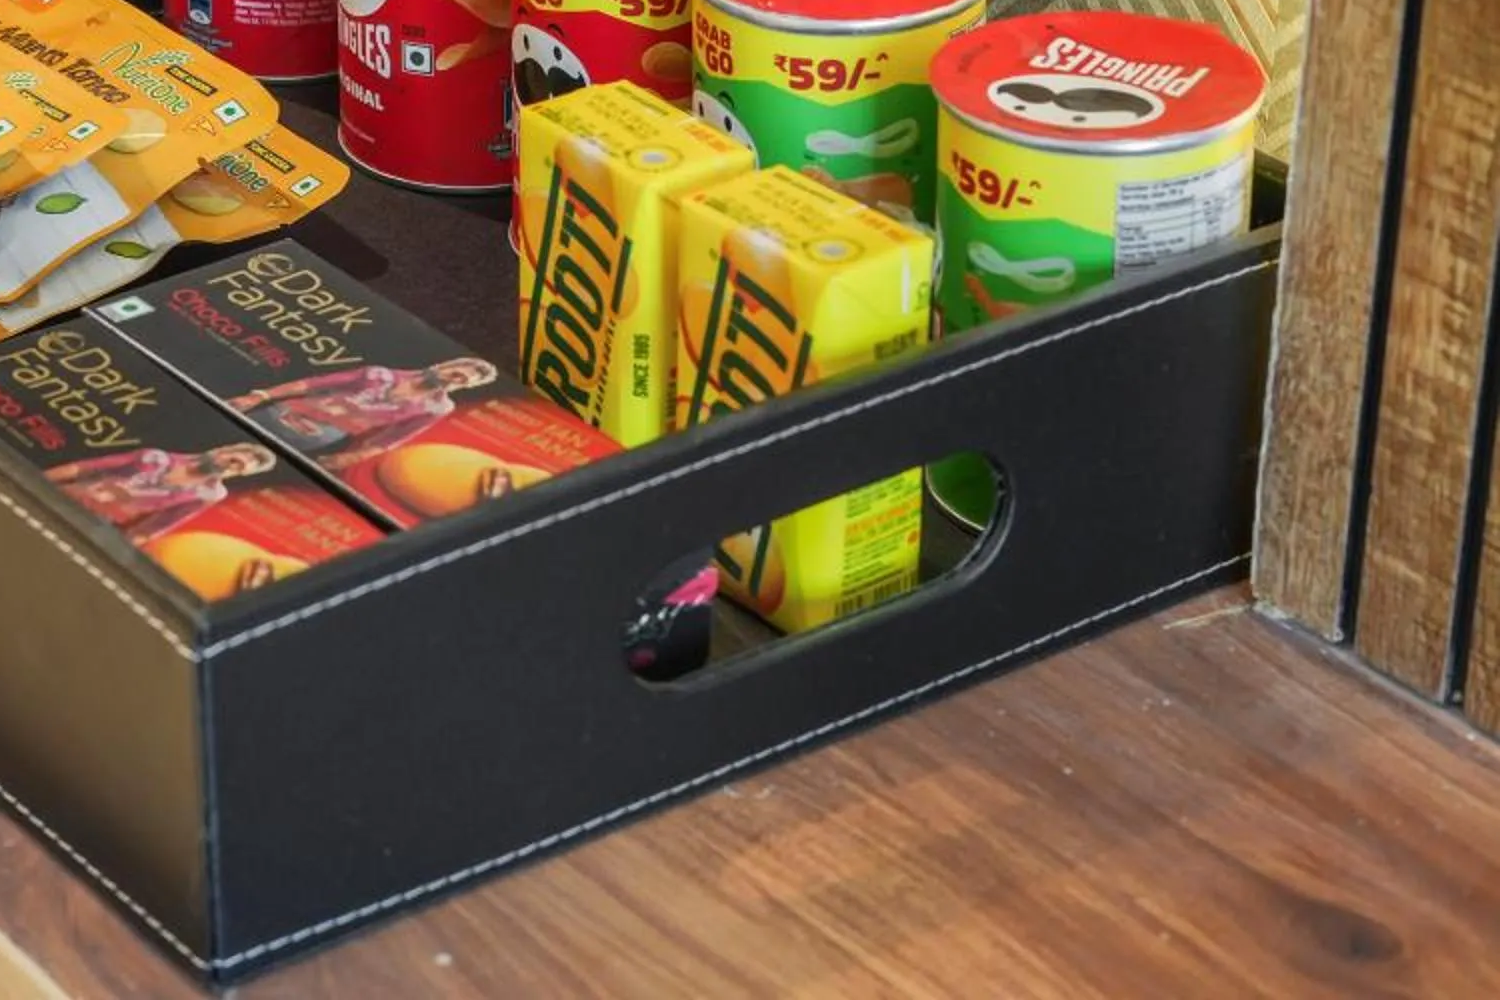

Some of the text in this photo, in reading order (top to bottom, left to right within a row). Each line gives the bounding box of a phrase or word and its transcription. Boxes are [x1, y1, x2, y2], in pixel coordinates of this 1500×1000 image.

[338, 14, 391, 80] NGLES
[695, 10, 731, 50] GRAB
[706, 43, 734, 75] GO
[1029, 36, 1211, 98] PRINGLES
[171, 287, 242, 337] Choco
[206, 269, 364, 367] Fantasy
[269, 269, 373, 334] Dark
[535, 178, 619, 426] ROOTI
[60, 347, 159, 415] Dark
[631, 364, 650, 399] SINCE
